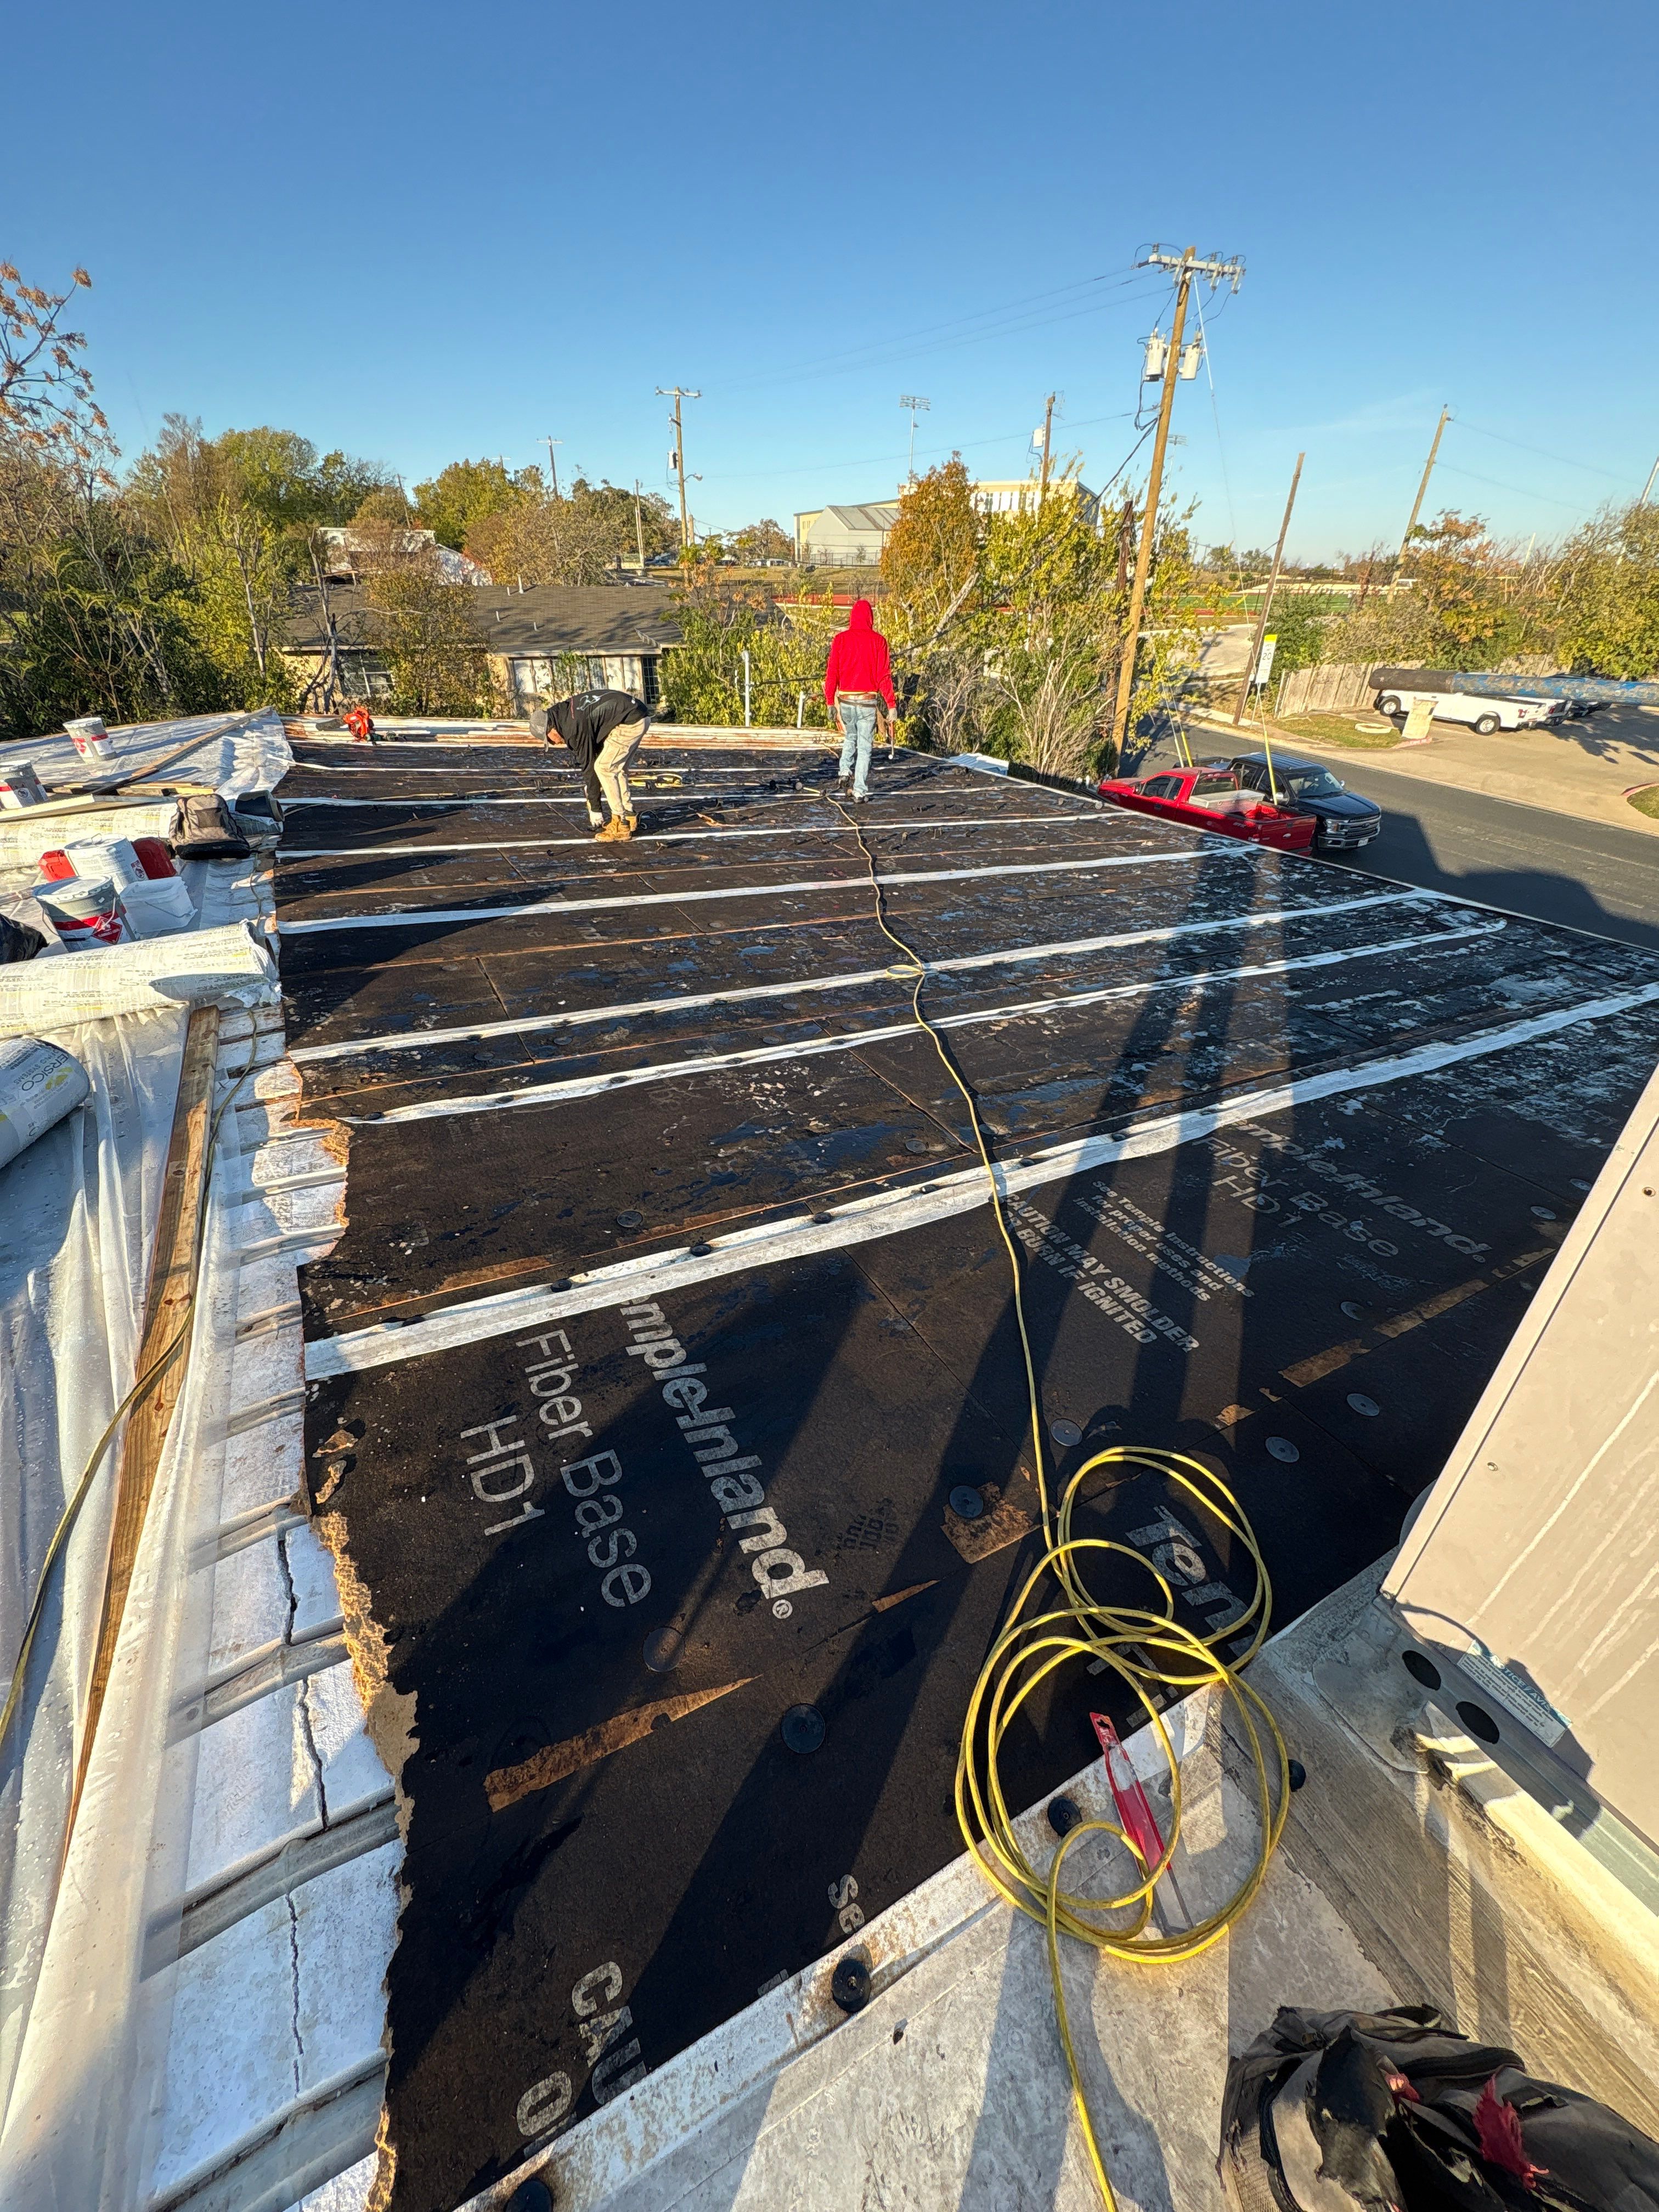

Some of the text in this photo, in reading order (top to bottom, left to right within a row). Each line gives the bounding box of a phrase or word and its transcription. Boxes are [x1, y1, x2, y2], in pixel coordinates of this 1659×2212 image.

[1262, 652, 1272, 661] 20
[21, 1053, 70, 1091] ERSICO
[1091, 1195, 1226, 1291] for proper uses and
[1092, 1181, 1119, 1199] See
[1118, 1197, 1166, 1232] Temple
[1192, 1136, 1399, 1256] Fiber Base
[1212, 1175, 1303, 1228] HD1
[1006, 1193, 1200, 1353] CAUTION MAY SMOLDER
[1017, 1228, 1066, 1266] BURN
[1057, 1264, 1087, 1280] IF
[1077, 1281, 1158, 1344] IGNITED
[1145, 1252, 1211, 1302] methods
[460, 1415, 546, 1536] HD1
[516, 1329, 652, 1607] Fiber Base
[1125, 1505, 1261, 1658] Tem
[827, 1874, 866, 1934] Se
[571, 1961, 647, 2106] CAU
